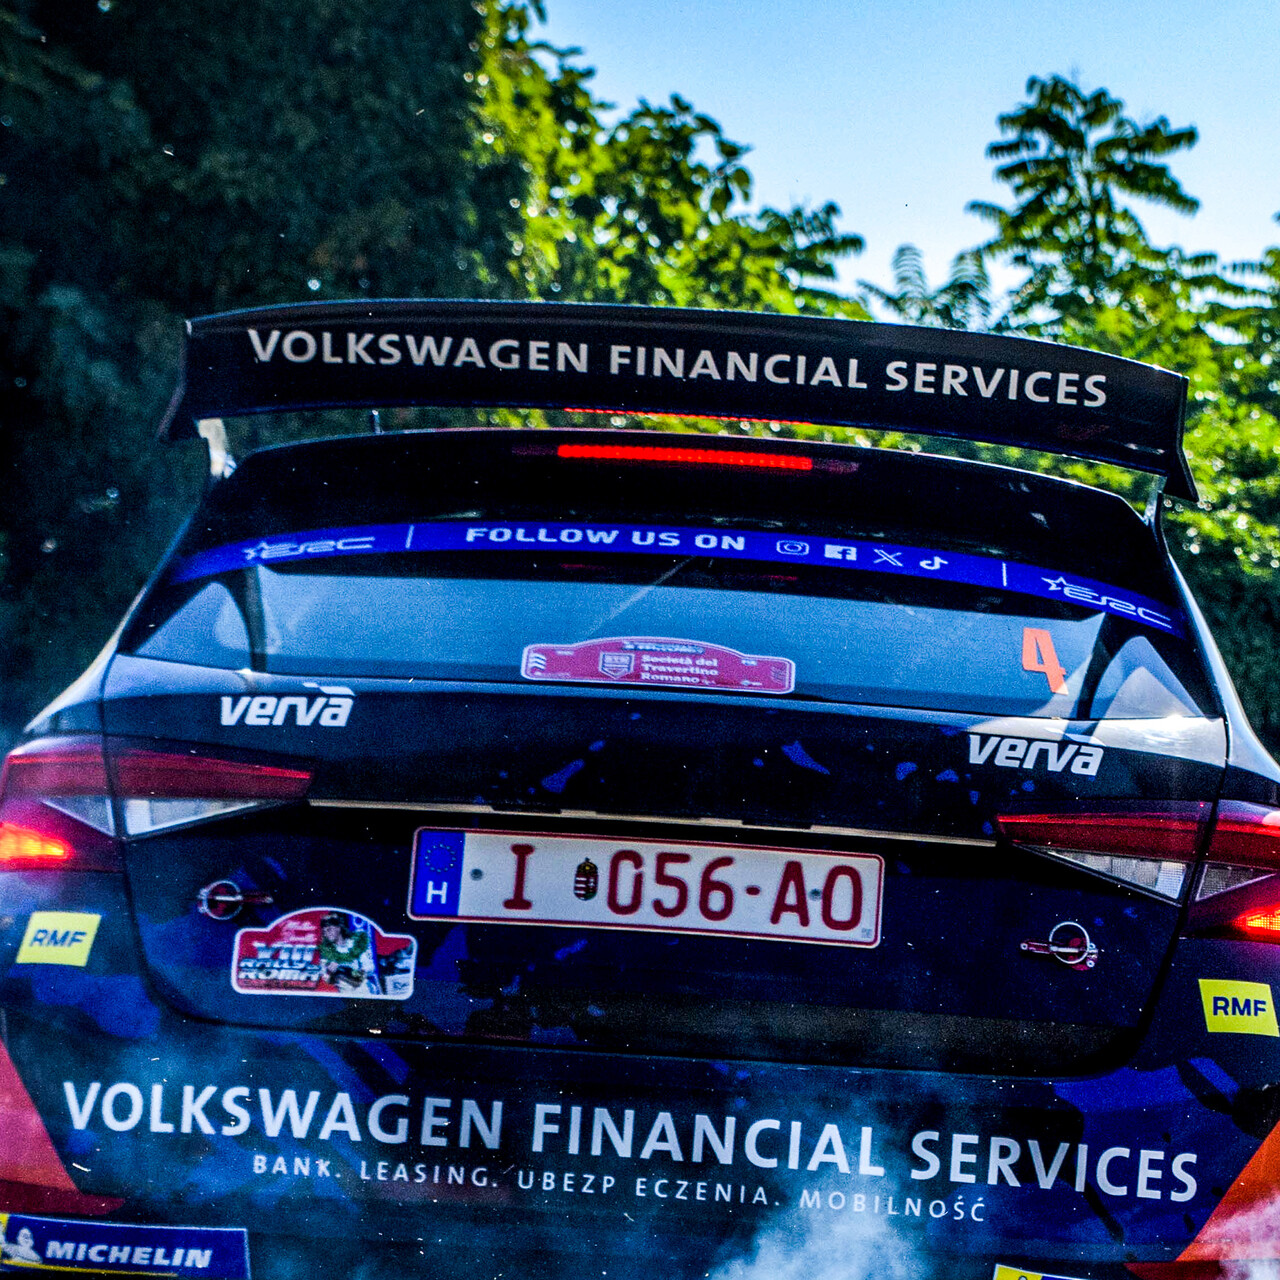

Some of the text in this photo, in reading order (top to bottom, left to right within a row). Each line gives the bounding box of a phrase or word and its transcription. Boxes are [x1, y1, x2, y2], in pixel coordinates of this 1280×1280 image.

[247, 328, 1110, 408] VOLKSWAGEN FINANCIAL SERVICES
[466, 527, 746, 552] FOLLOW US ON
[695, 659, 718, 667] del
[1022, 627, 1069, 696] 4
[640, 672, 700, 684] Romano
[426, 880, 448, 905] H
[30, 926, 87, 949] RMF
[1212, 995, 1268, 1019] RMF
[63, 1080, 1198, 1202] VOLKSWAGEN FINANCIAL SERVICES
[253, 1155, 342, 1178] BANK.
[360, 1160, 498, 1188] LEASING.
[799, 1188, 986, 1222] MOBILNOŚĆ
[45, 1243, 213, 1270] MICHELIN
